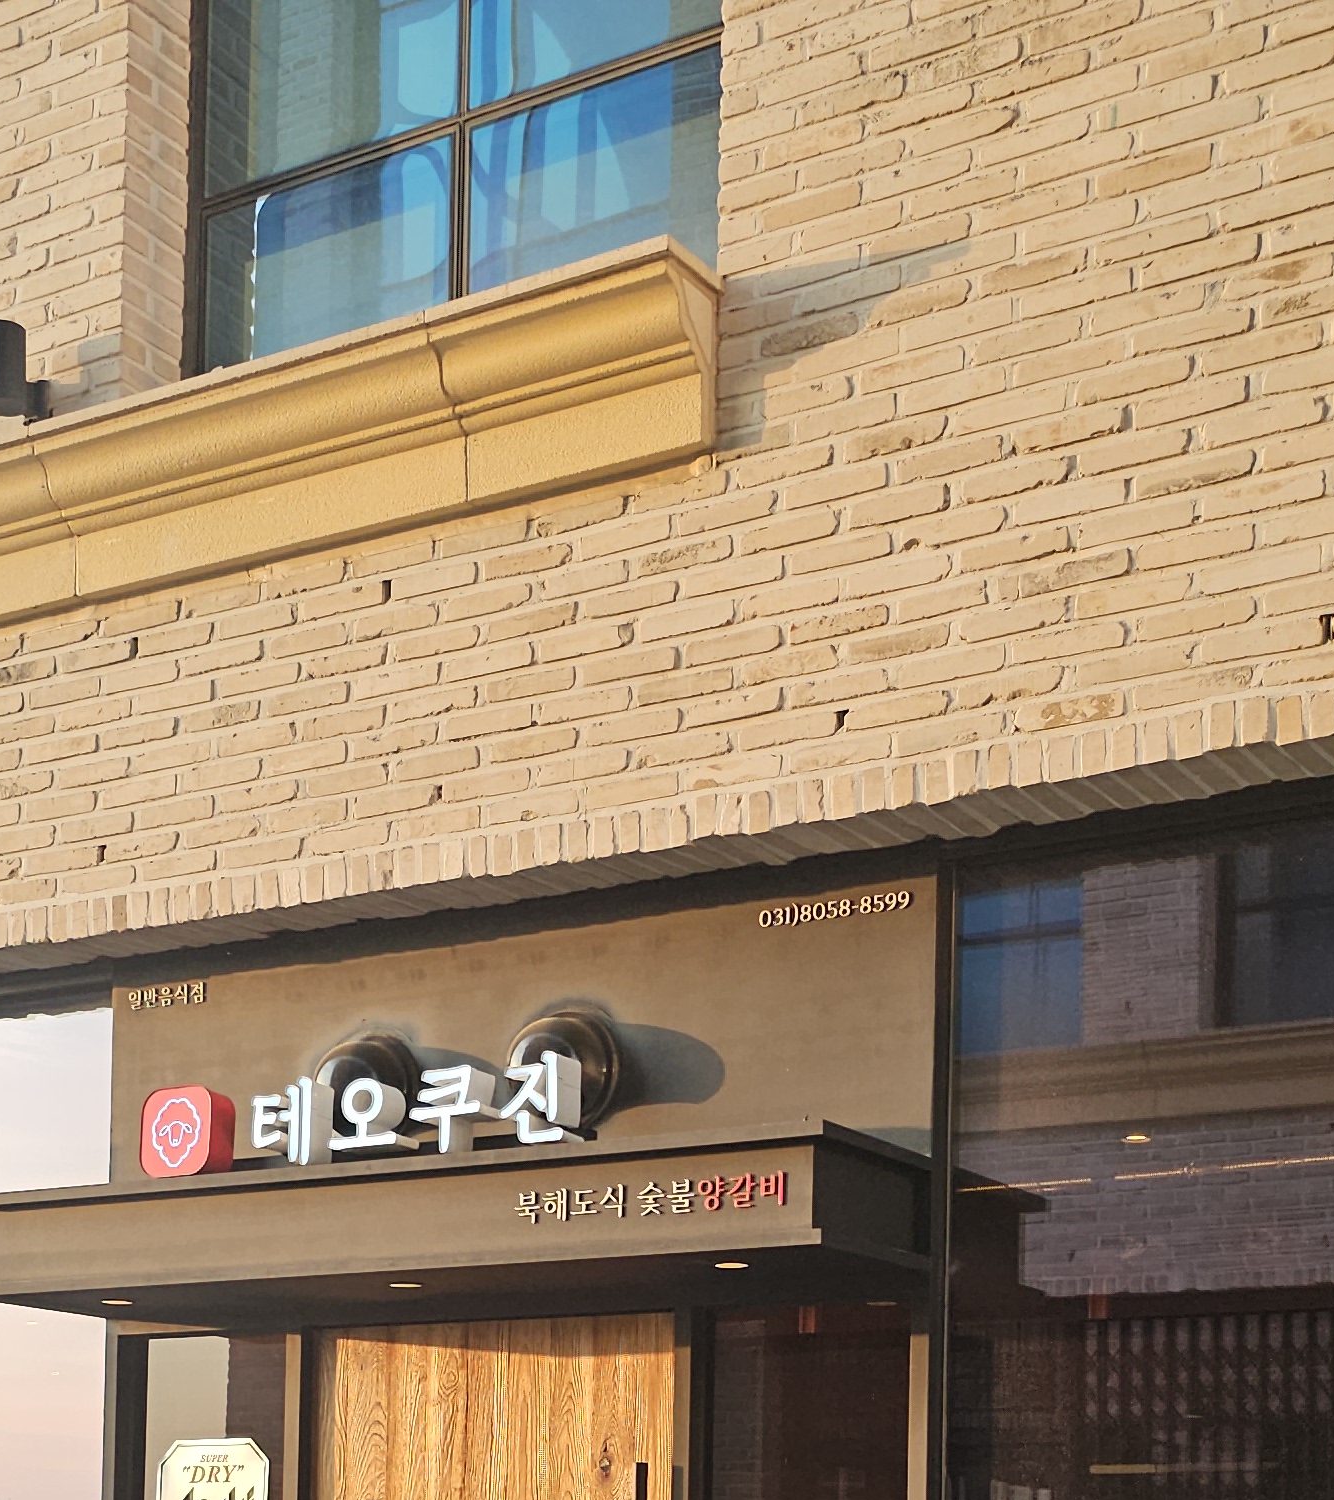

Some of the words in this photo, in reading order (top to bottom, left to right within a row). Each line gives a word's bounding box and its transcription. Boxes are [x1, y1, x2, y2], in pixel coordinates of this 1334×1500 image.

[758, 890, 911, 928] 031)8058-8599
[128, 981, 207, 1010] 일반음식점
[251, 1050, 575, 1166] 테오쿠진
[514, 1183, 626, 1224] 북해도식
[200, 1454, 229, 1463] SUPER
